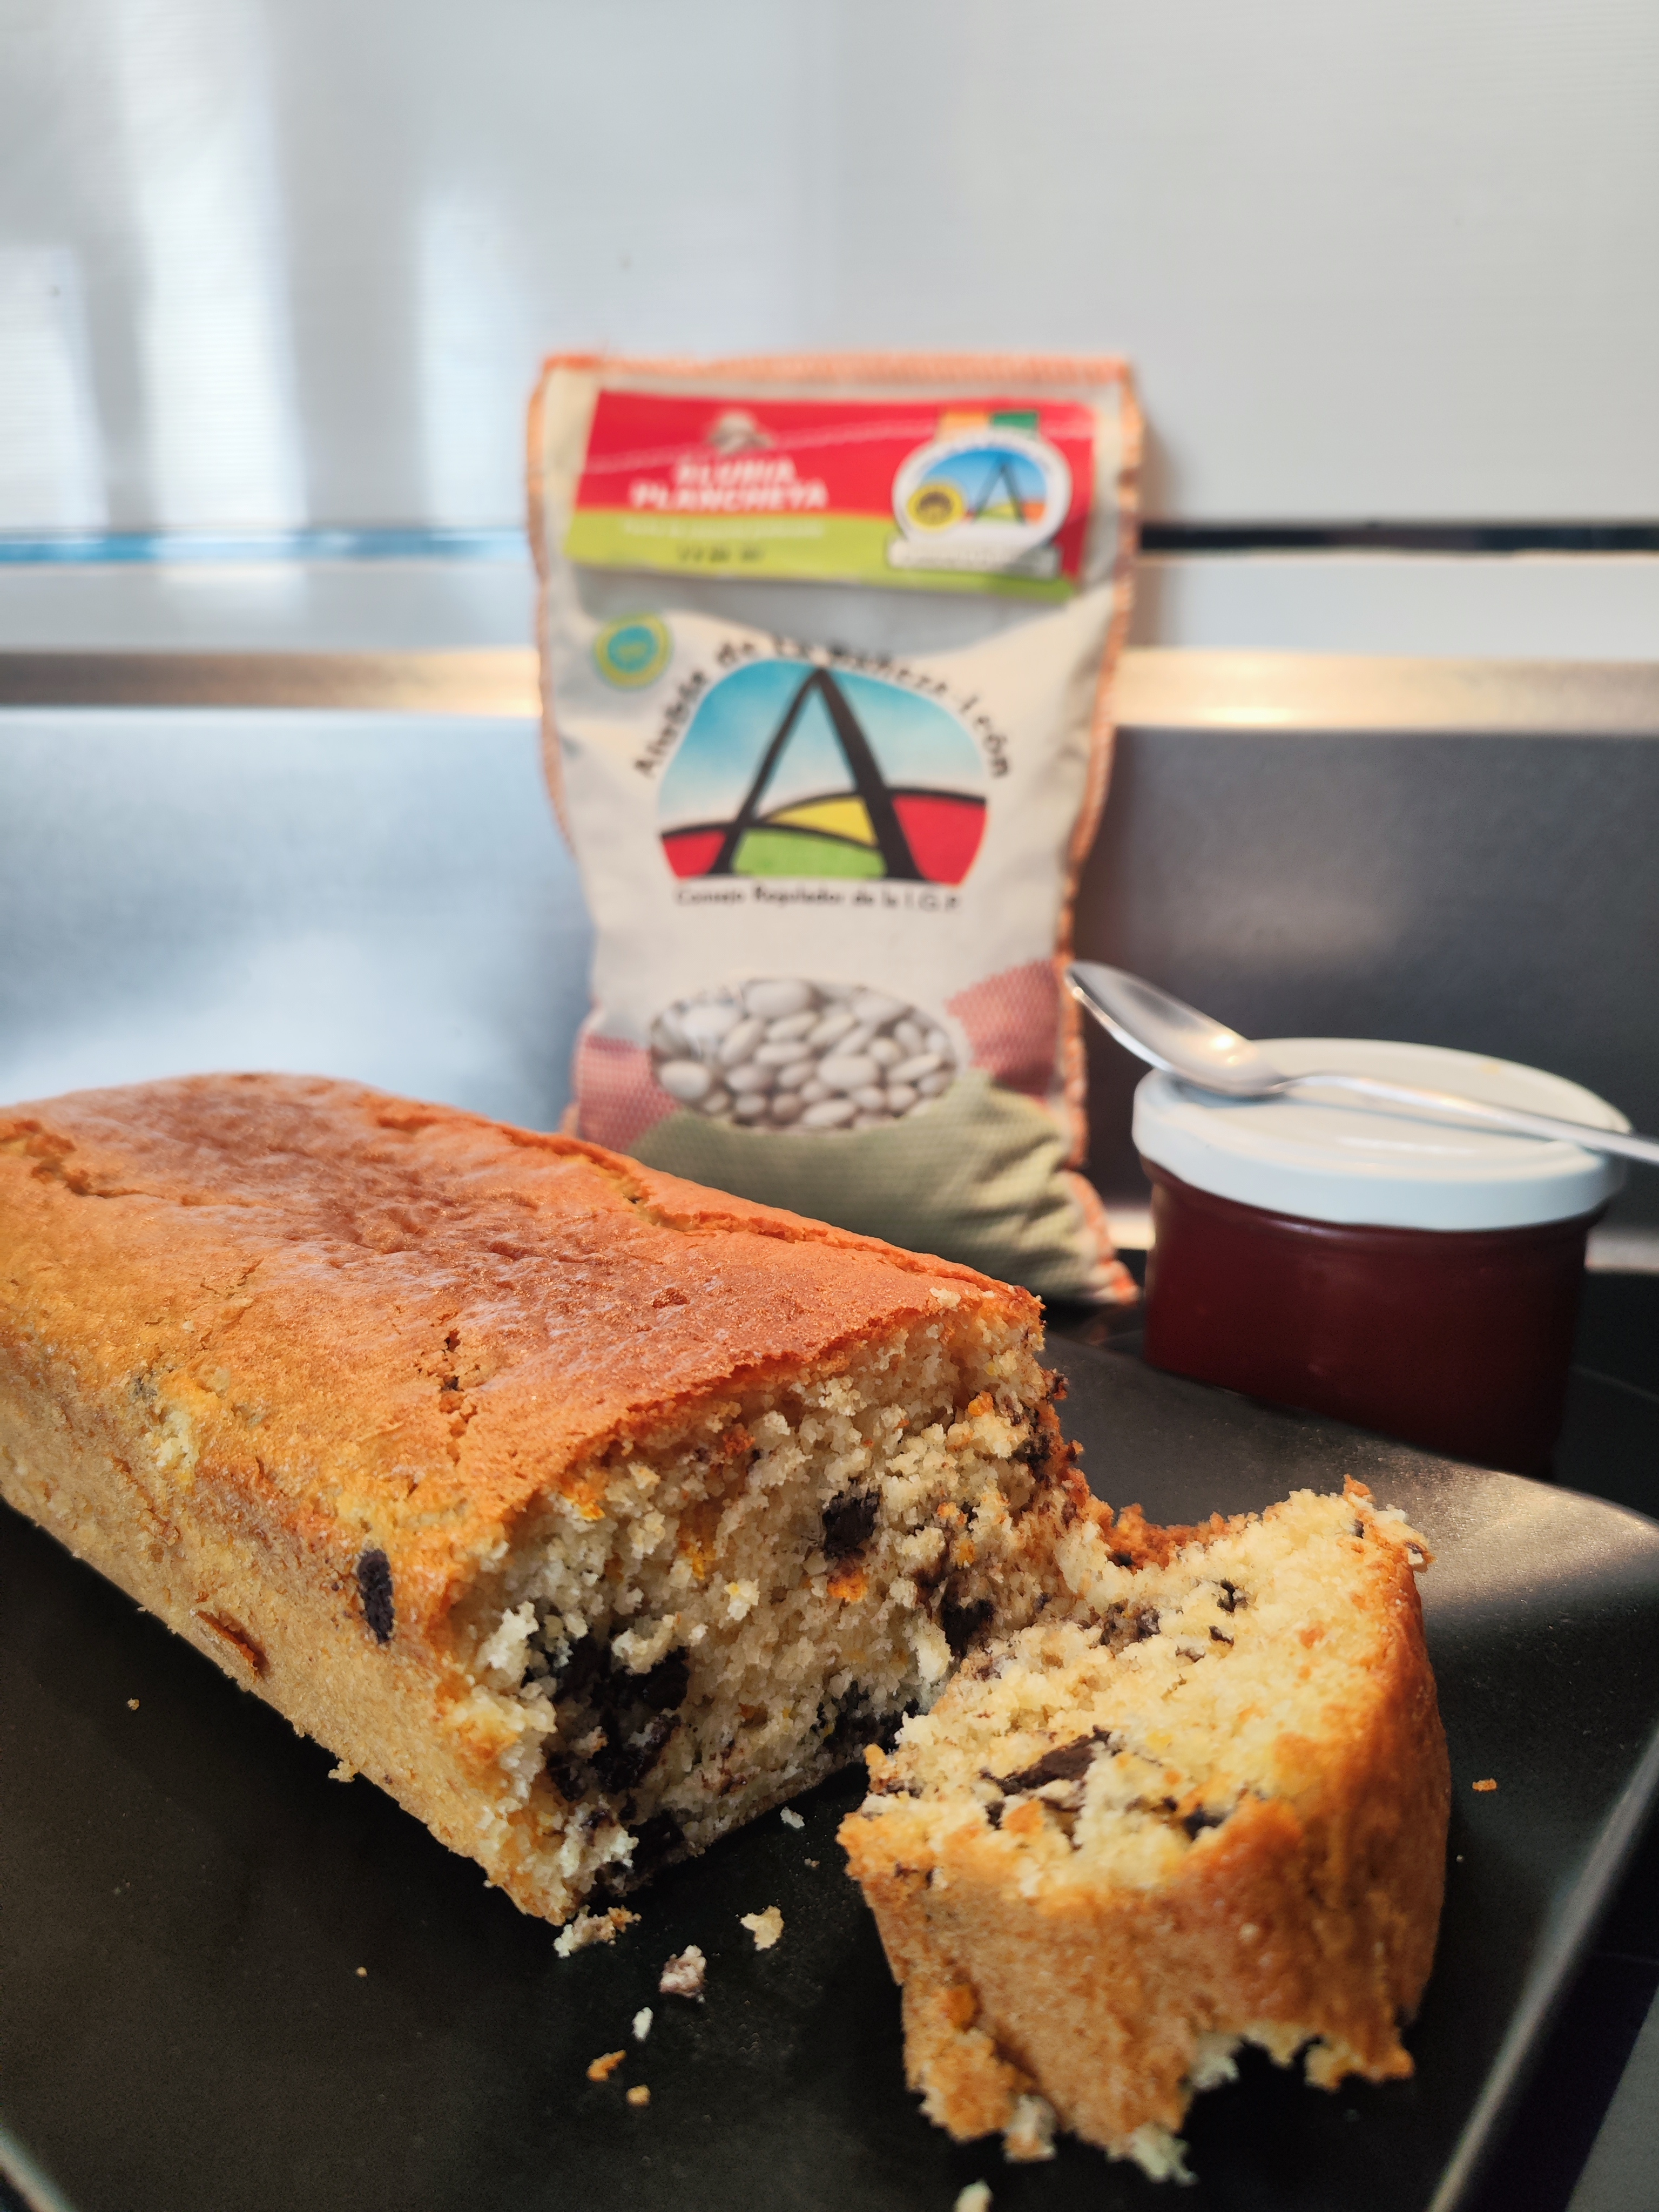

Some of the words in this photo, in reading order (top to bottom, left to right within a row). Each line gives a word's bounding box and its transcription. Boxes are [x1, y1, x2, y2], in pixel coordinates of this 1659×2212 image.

[629, 480, 827, 511] PLANCHETA
[634, 669, 706, 778] Alubia
[713, 641, 755, 669] de
[677, 886, 743, 907] Consejo
[755, 884, 844, 909] Regulador
[852, 886, 875, 907] de
[881, 886, 899, 908] la
